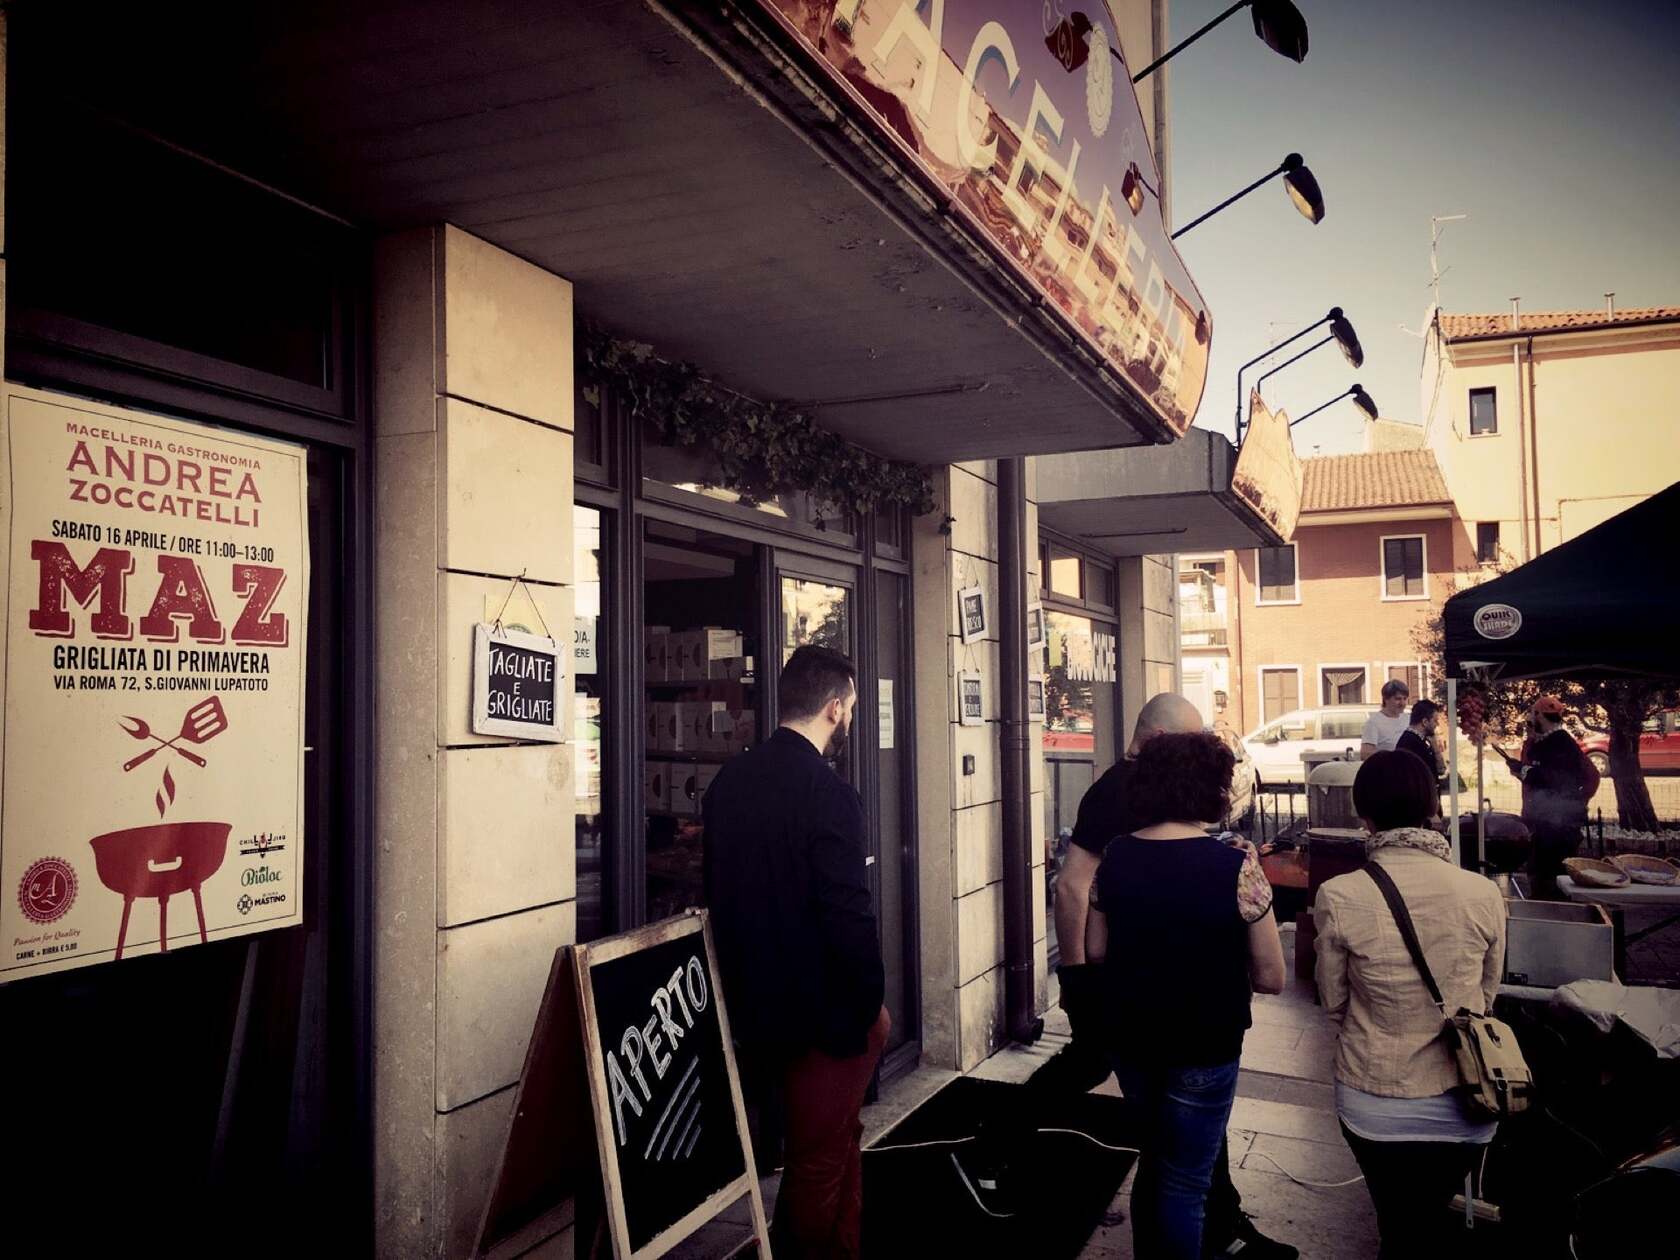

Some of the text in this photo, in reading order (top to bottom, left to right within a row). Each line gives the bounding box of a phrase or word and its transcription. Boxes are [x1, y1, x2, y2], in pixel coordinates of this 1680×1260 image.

[829, 0, 1186, 390] ACELLERIA
[66, 421, 261, 470] MACELLERIA GASTRONOMIA
[66, 440, 262, 503] ANDREA
[69, 478, 260, 528] ZOCCATELLI
[52, 519, 102, 543] SABATO
[106, 526, 121, 545] 16
[125, 530, 167, 551] APRILE
[178, 537, 202, 555] ORE
[28, 539, 289, 648] MAZ
[1482, 611, 1512, 621] QUIK
[54, 645, 270, 674] GRIGLIATA DI PRIMAVERA
[488, 648, 552, 682] TAGLIATE
[54, 675, 268, 693] VIA ROMA 72, S.GIOVANNI LUPATOTO
[513, 682, 521, 695] E
[487, 690, 552, 722] GRIGLIATE
[254, 893, 286, 907] MASTINO
[55, 928, 81, 941] Quality
[16, 949, 35, 961] CARNE
[606, 955, 708, 1147] APERTO
